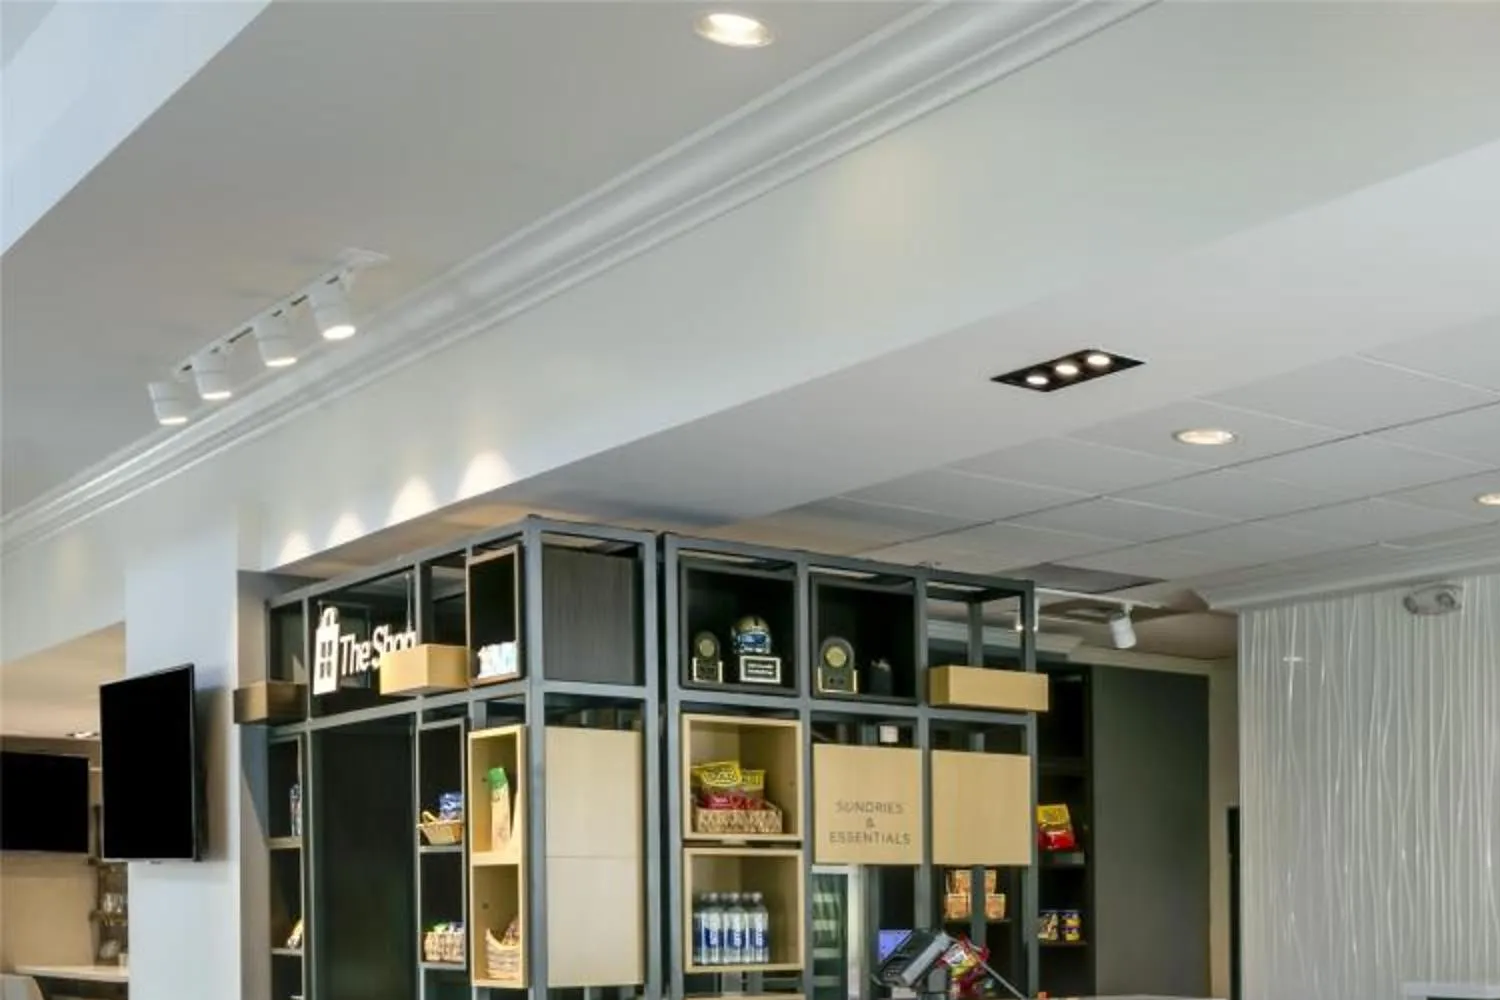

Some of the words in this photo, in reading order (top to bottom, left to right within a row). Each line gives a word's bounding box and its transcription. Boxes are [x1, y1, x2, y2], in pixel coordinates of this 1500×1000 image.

[340, 633, 371, 676] The
[835, 800, 905, 815] SUNDRIES
[829, 831, 911, 845] ESSENTIALS
